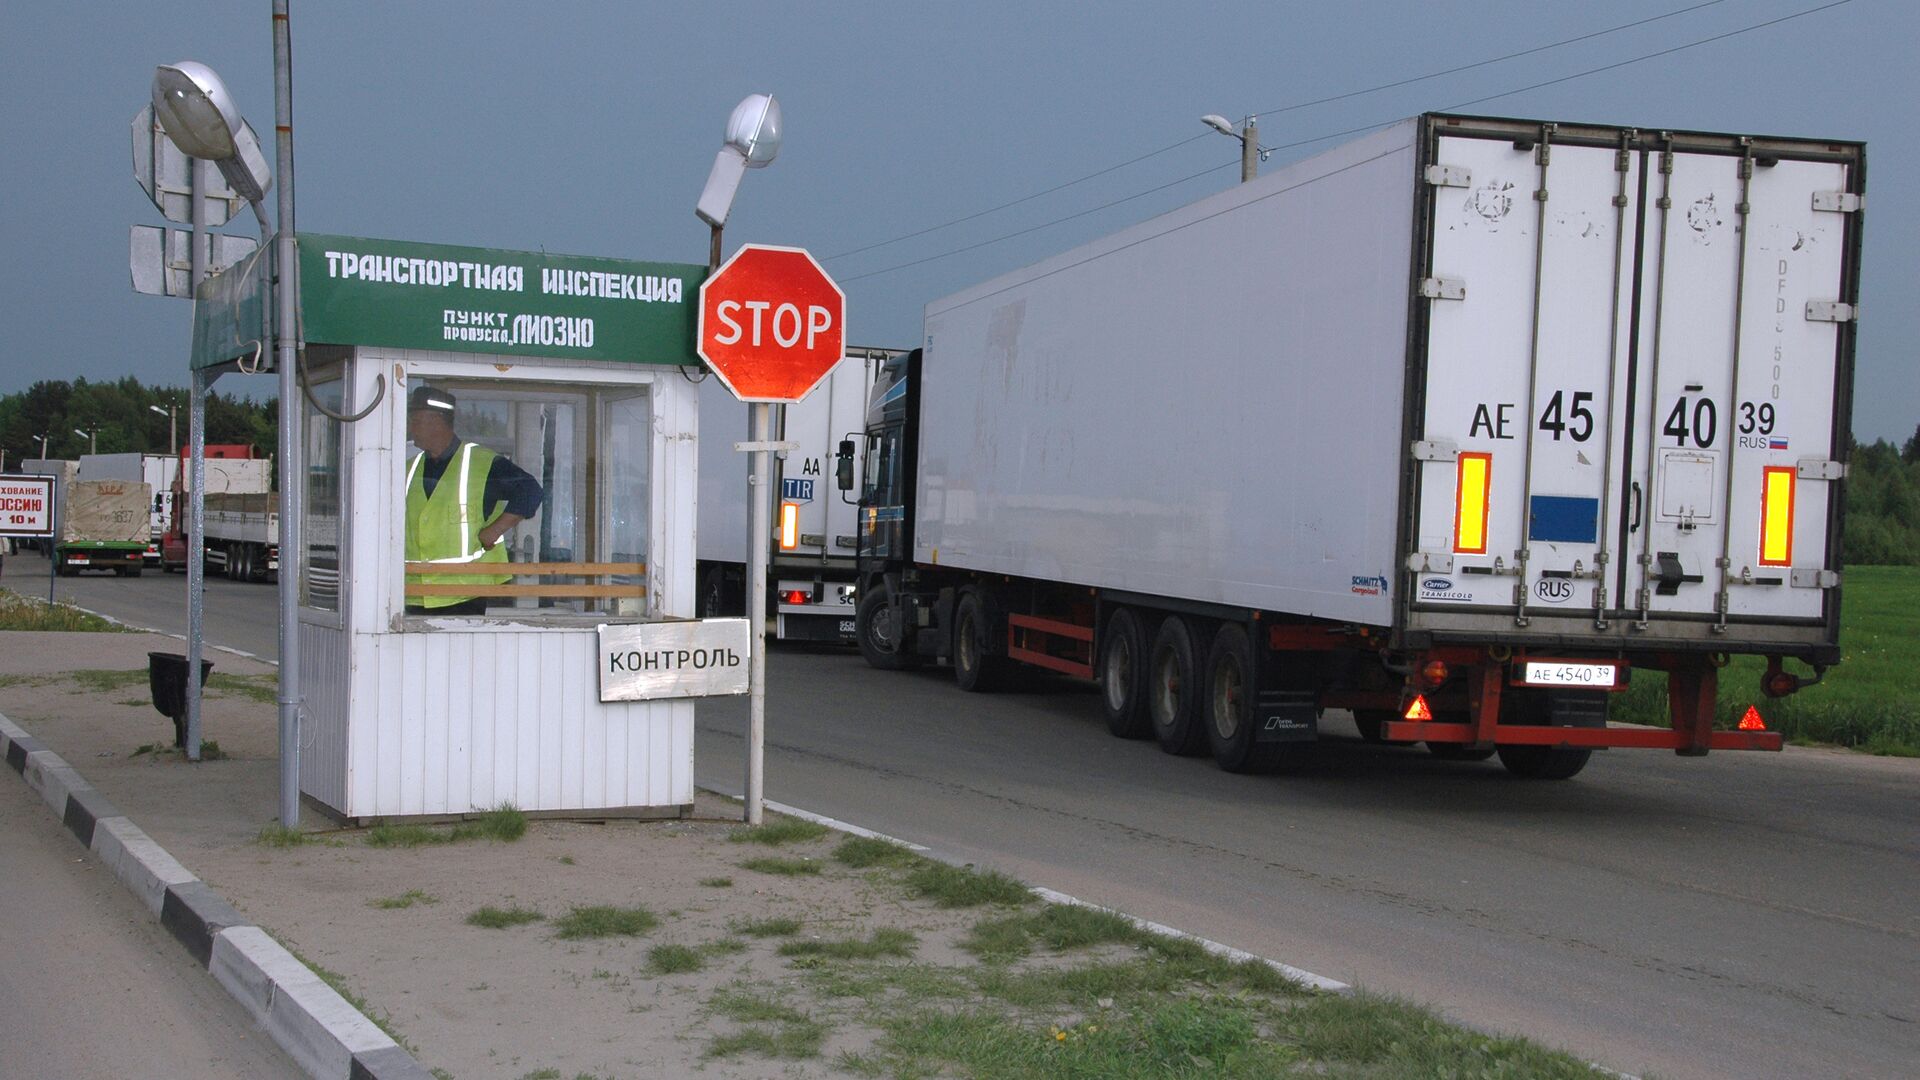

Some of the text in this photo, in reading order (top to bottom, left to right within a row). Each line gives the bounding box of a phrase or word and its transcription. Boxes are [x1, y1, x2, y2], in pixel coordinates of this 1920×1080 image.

[325, 251, 683, 303] ТРАНСПОРТНАЯ ИНСПЕКЦИЯ
[443, 309, 508, 327] ПУНКТ
[714, 300, 832, 350] STOP
[443, 326, 509, 343] ПРОПУСКА
[1469, 390, 1776, 449] AE 45 40 39
[1738, 437, 1767, 449] RUS
[802, 457, 820, 476] AA
[786, 479, 812, 499] TIR
[9, 514, 25, 524] 10
[1423, 580, 1452, 590] Carrier
[1538, 580, 1571, 598] RUS
[1421, 591, 1473, 599] TRANSICOLD
[610, 648, 740, 673] КОНТРОЛЬ
[1533, 667, 1610, 682] AE 4540 39
